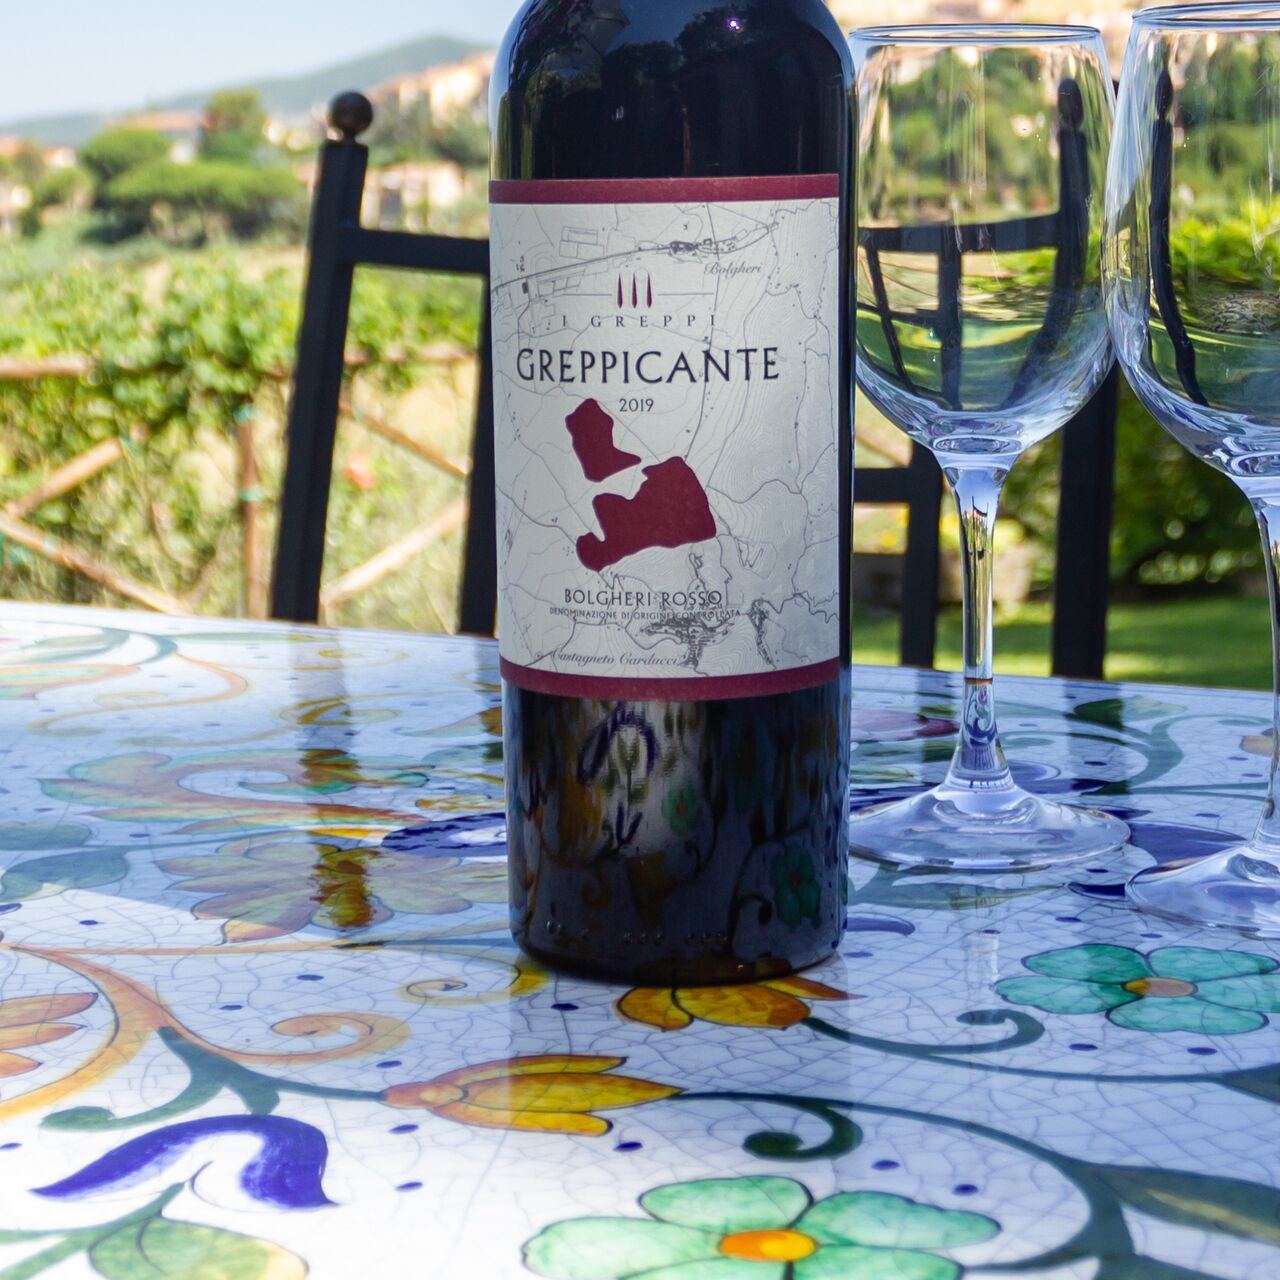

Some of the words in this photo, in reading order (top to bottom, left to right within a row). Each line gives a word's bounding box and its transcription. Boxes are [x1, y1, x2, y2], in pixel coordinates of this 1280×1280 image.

[704, 261, 762, 278] Bolgheri
[590, 314, 716, 328] GREPPI
[516, 346, 780, 384] GREPPICANTE
[618, 397, 655, 414] 2019
[564, 588, 652, 607] BOLGHERI
[662, 590, 722, 607] ROSSO
[549, 607, 618, 620] DENOMINAZIONE
[621, 611, 630, 620] DI
[632, 610, 671, 620] ORIGINE
[552, 650, 615, 667] Castagneto
[619, 651, 680, 667] Carducci
